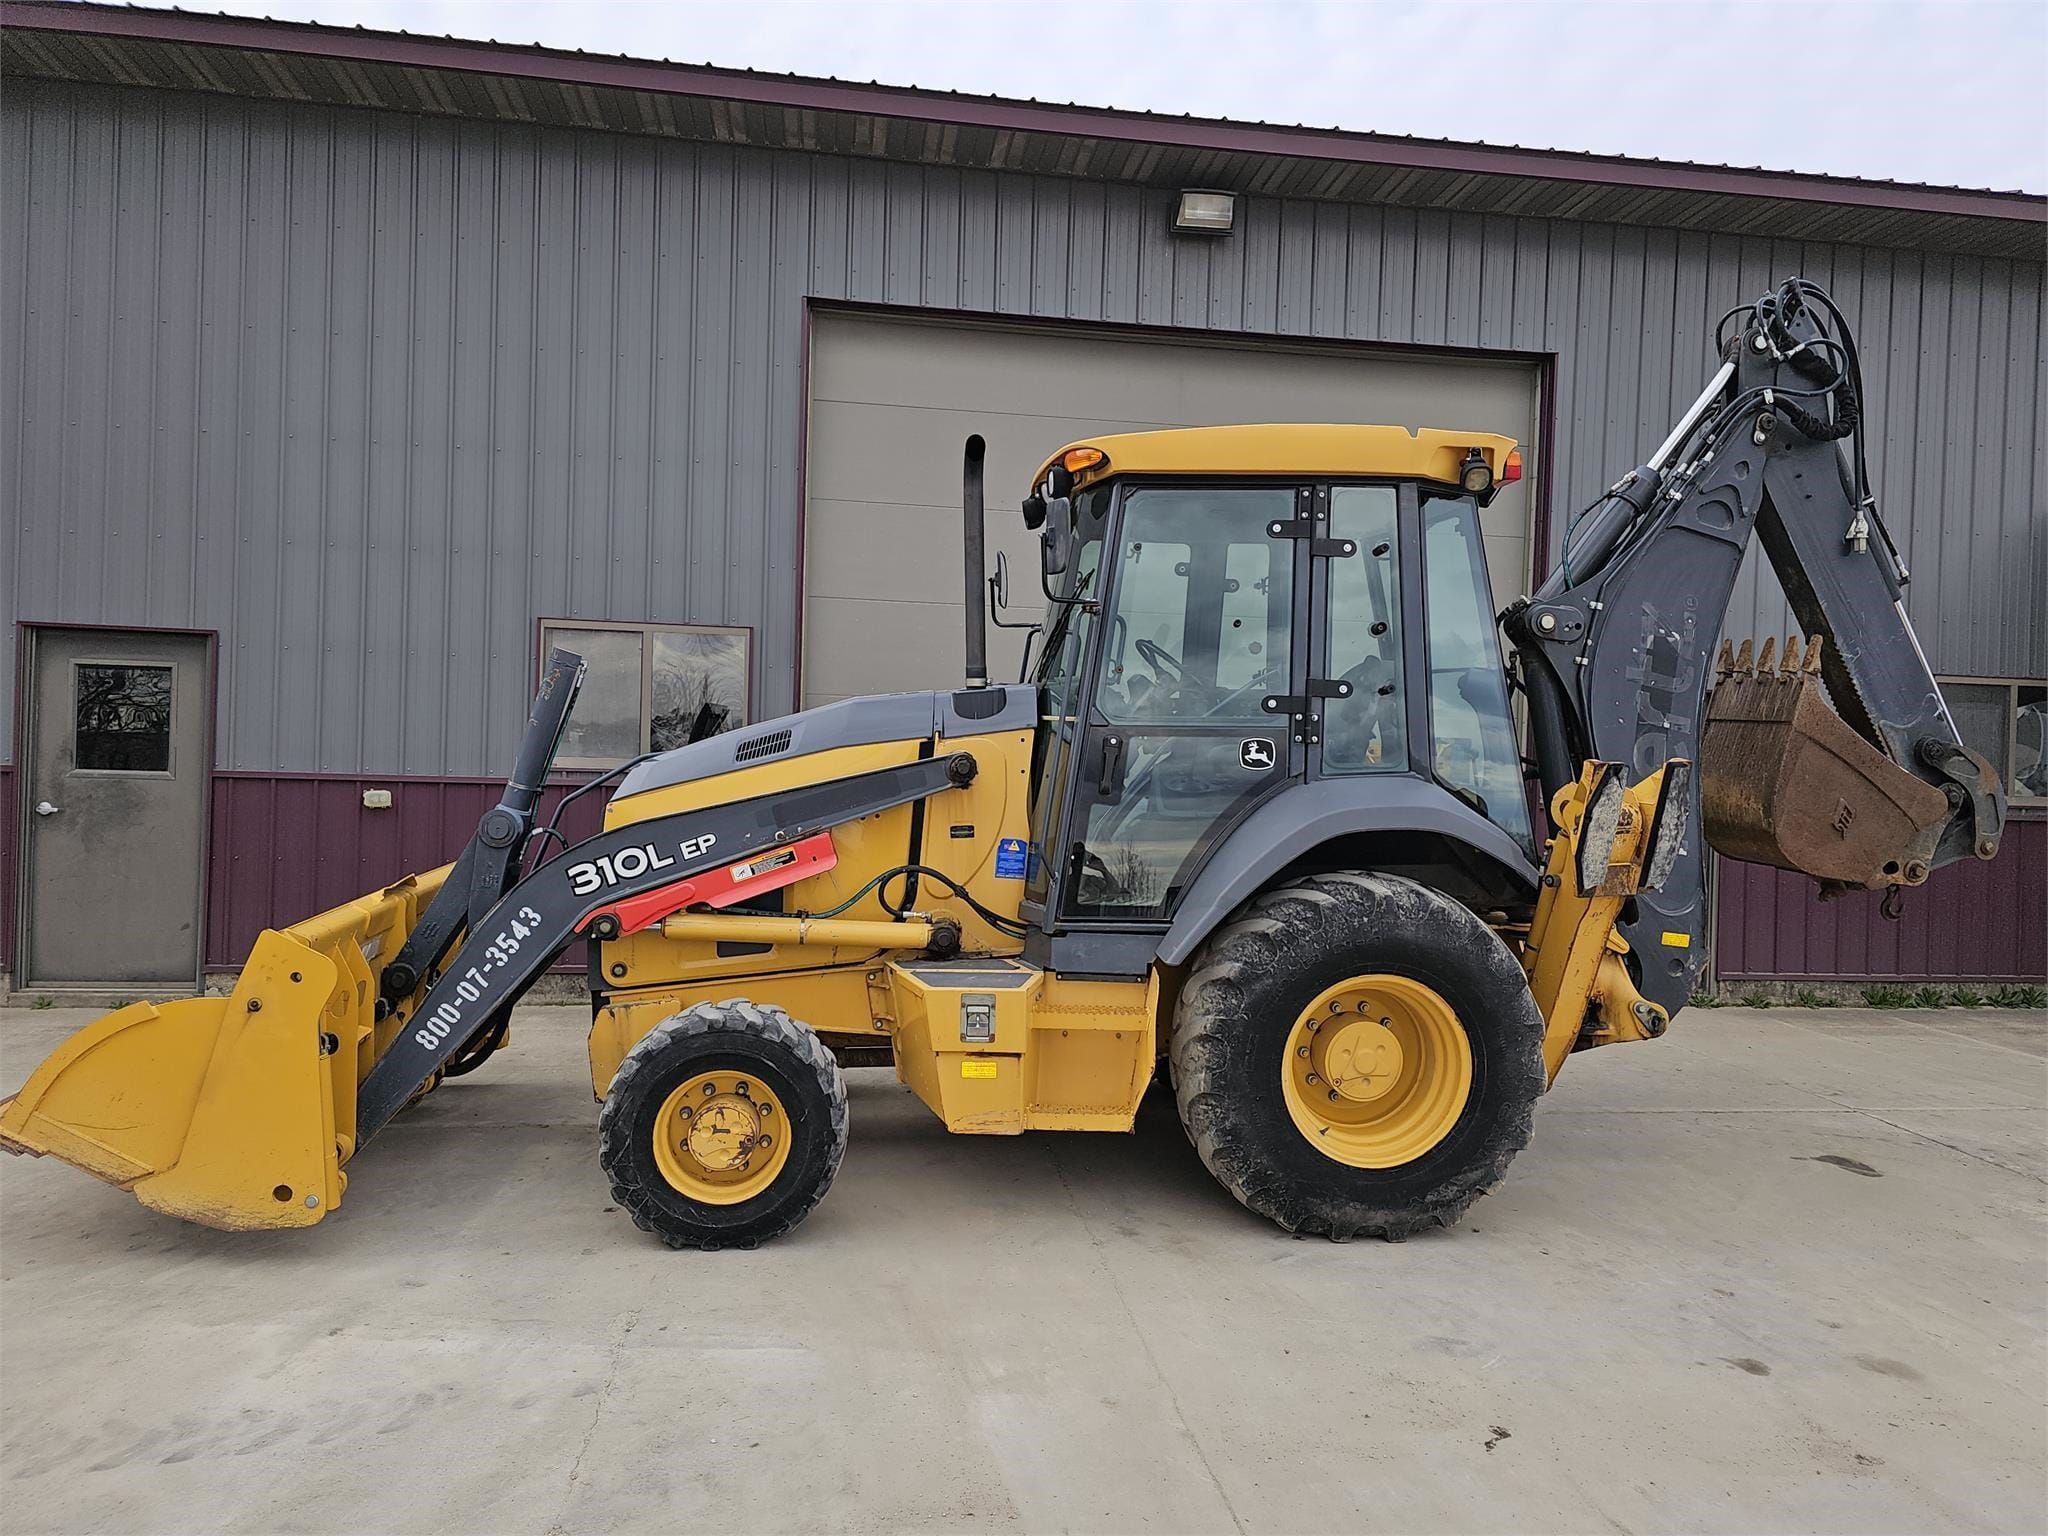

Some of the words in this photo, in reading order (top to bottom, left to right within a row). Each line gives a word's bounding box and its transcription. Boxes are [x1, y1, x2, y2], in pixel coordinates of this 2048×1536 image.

[567, 844, 674, 896] 310L
[679, 833, 718, 862] EP
[415, 906, 542, 1051] 800-07-3543
